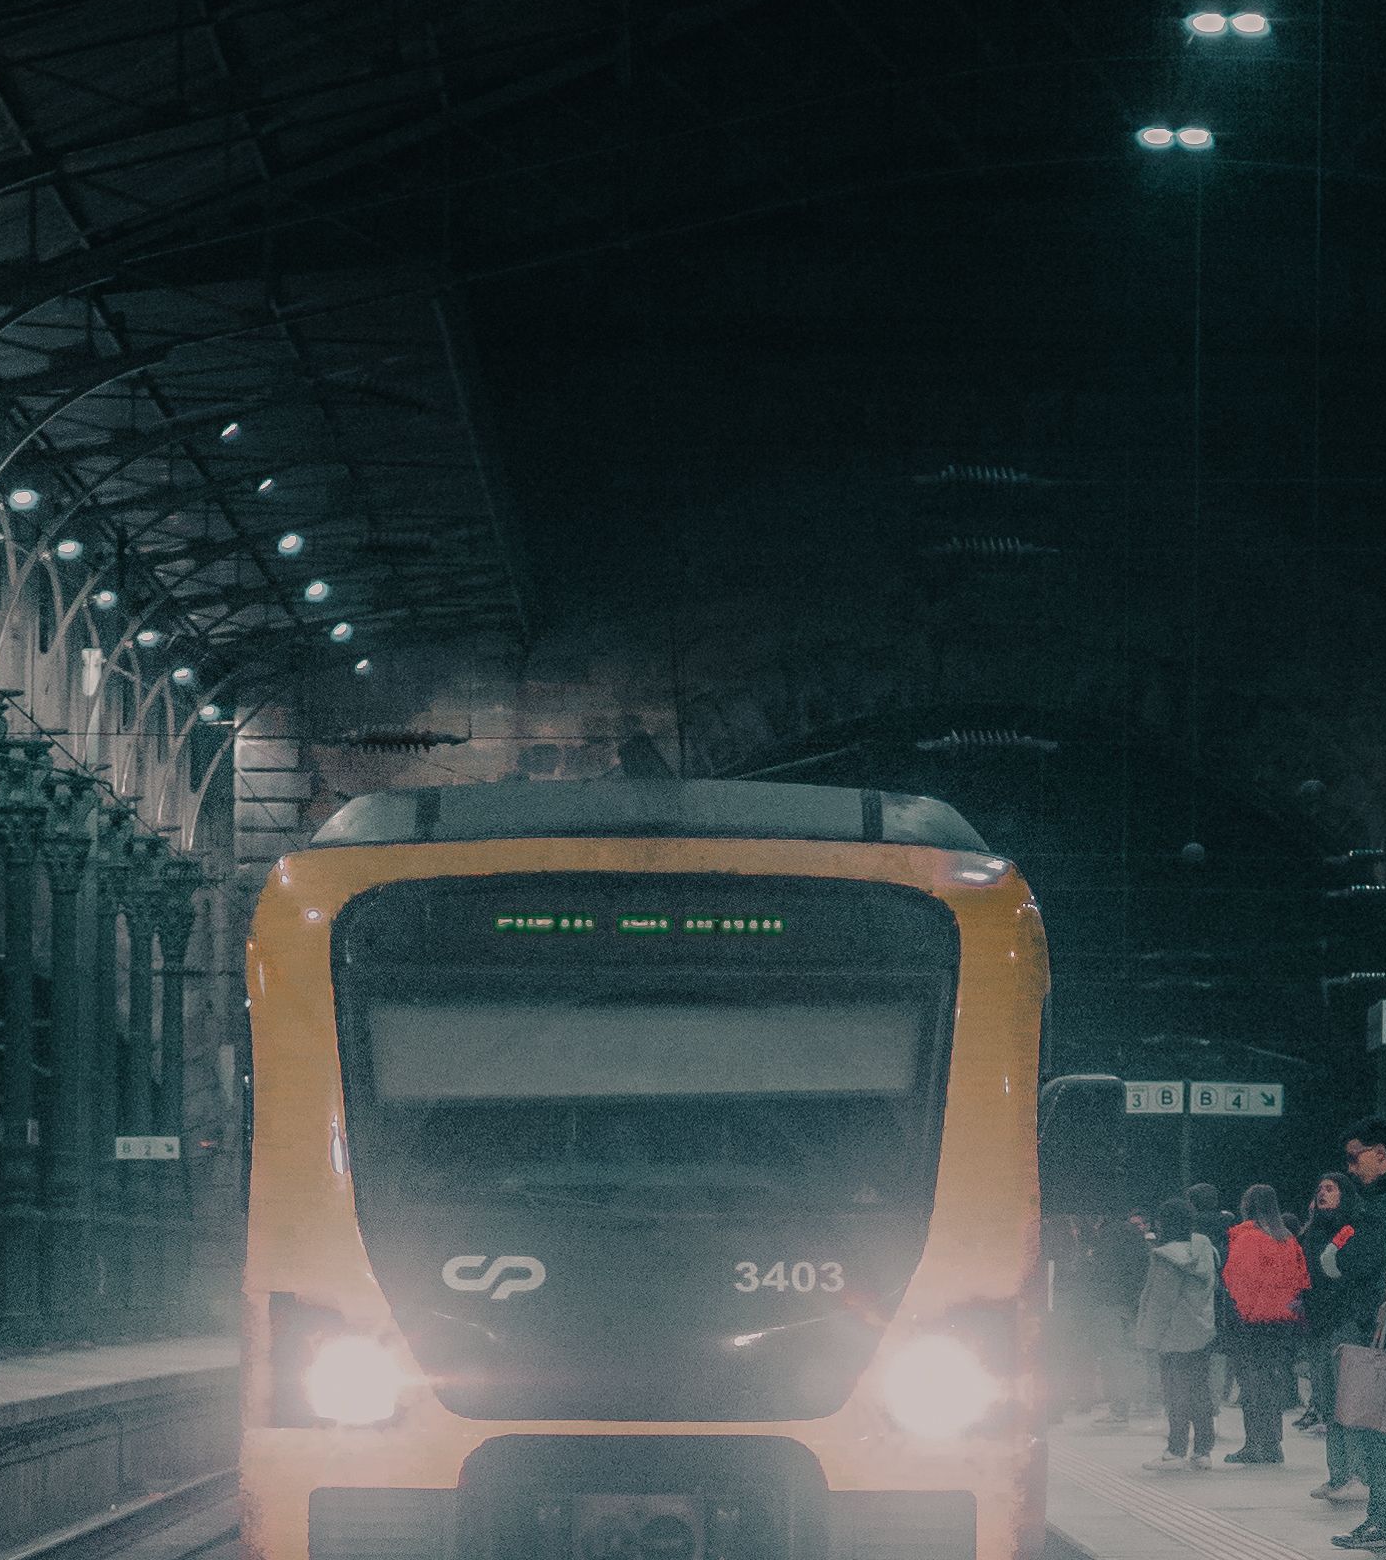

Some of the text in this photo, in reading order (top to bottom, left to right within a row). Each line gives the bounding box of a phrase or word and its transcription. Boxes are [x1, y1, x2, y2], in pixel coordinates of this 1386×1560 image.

[1132, 1091, 1174, 1108] 3 B
[1200, 1091, 1241, 1109] B 4
[733, 1261, 844, 1293] 3403
